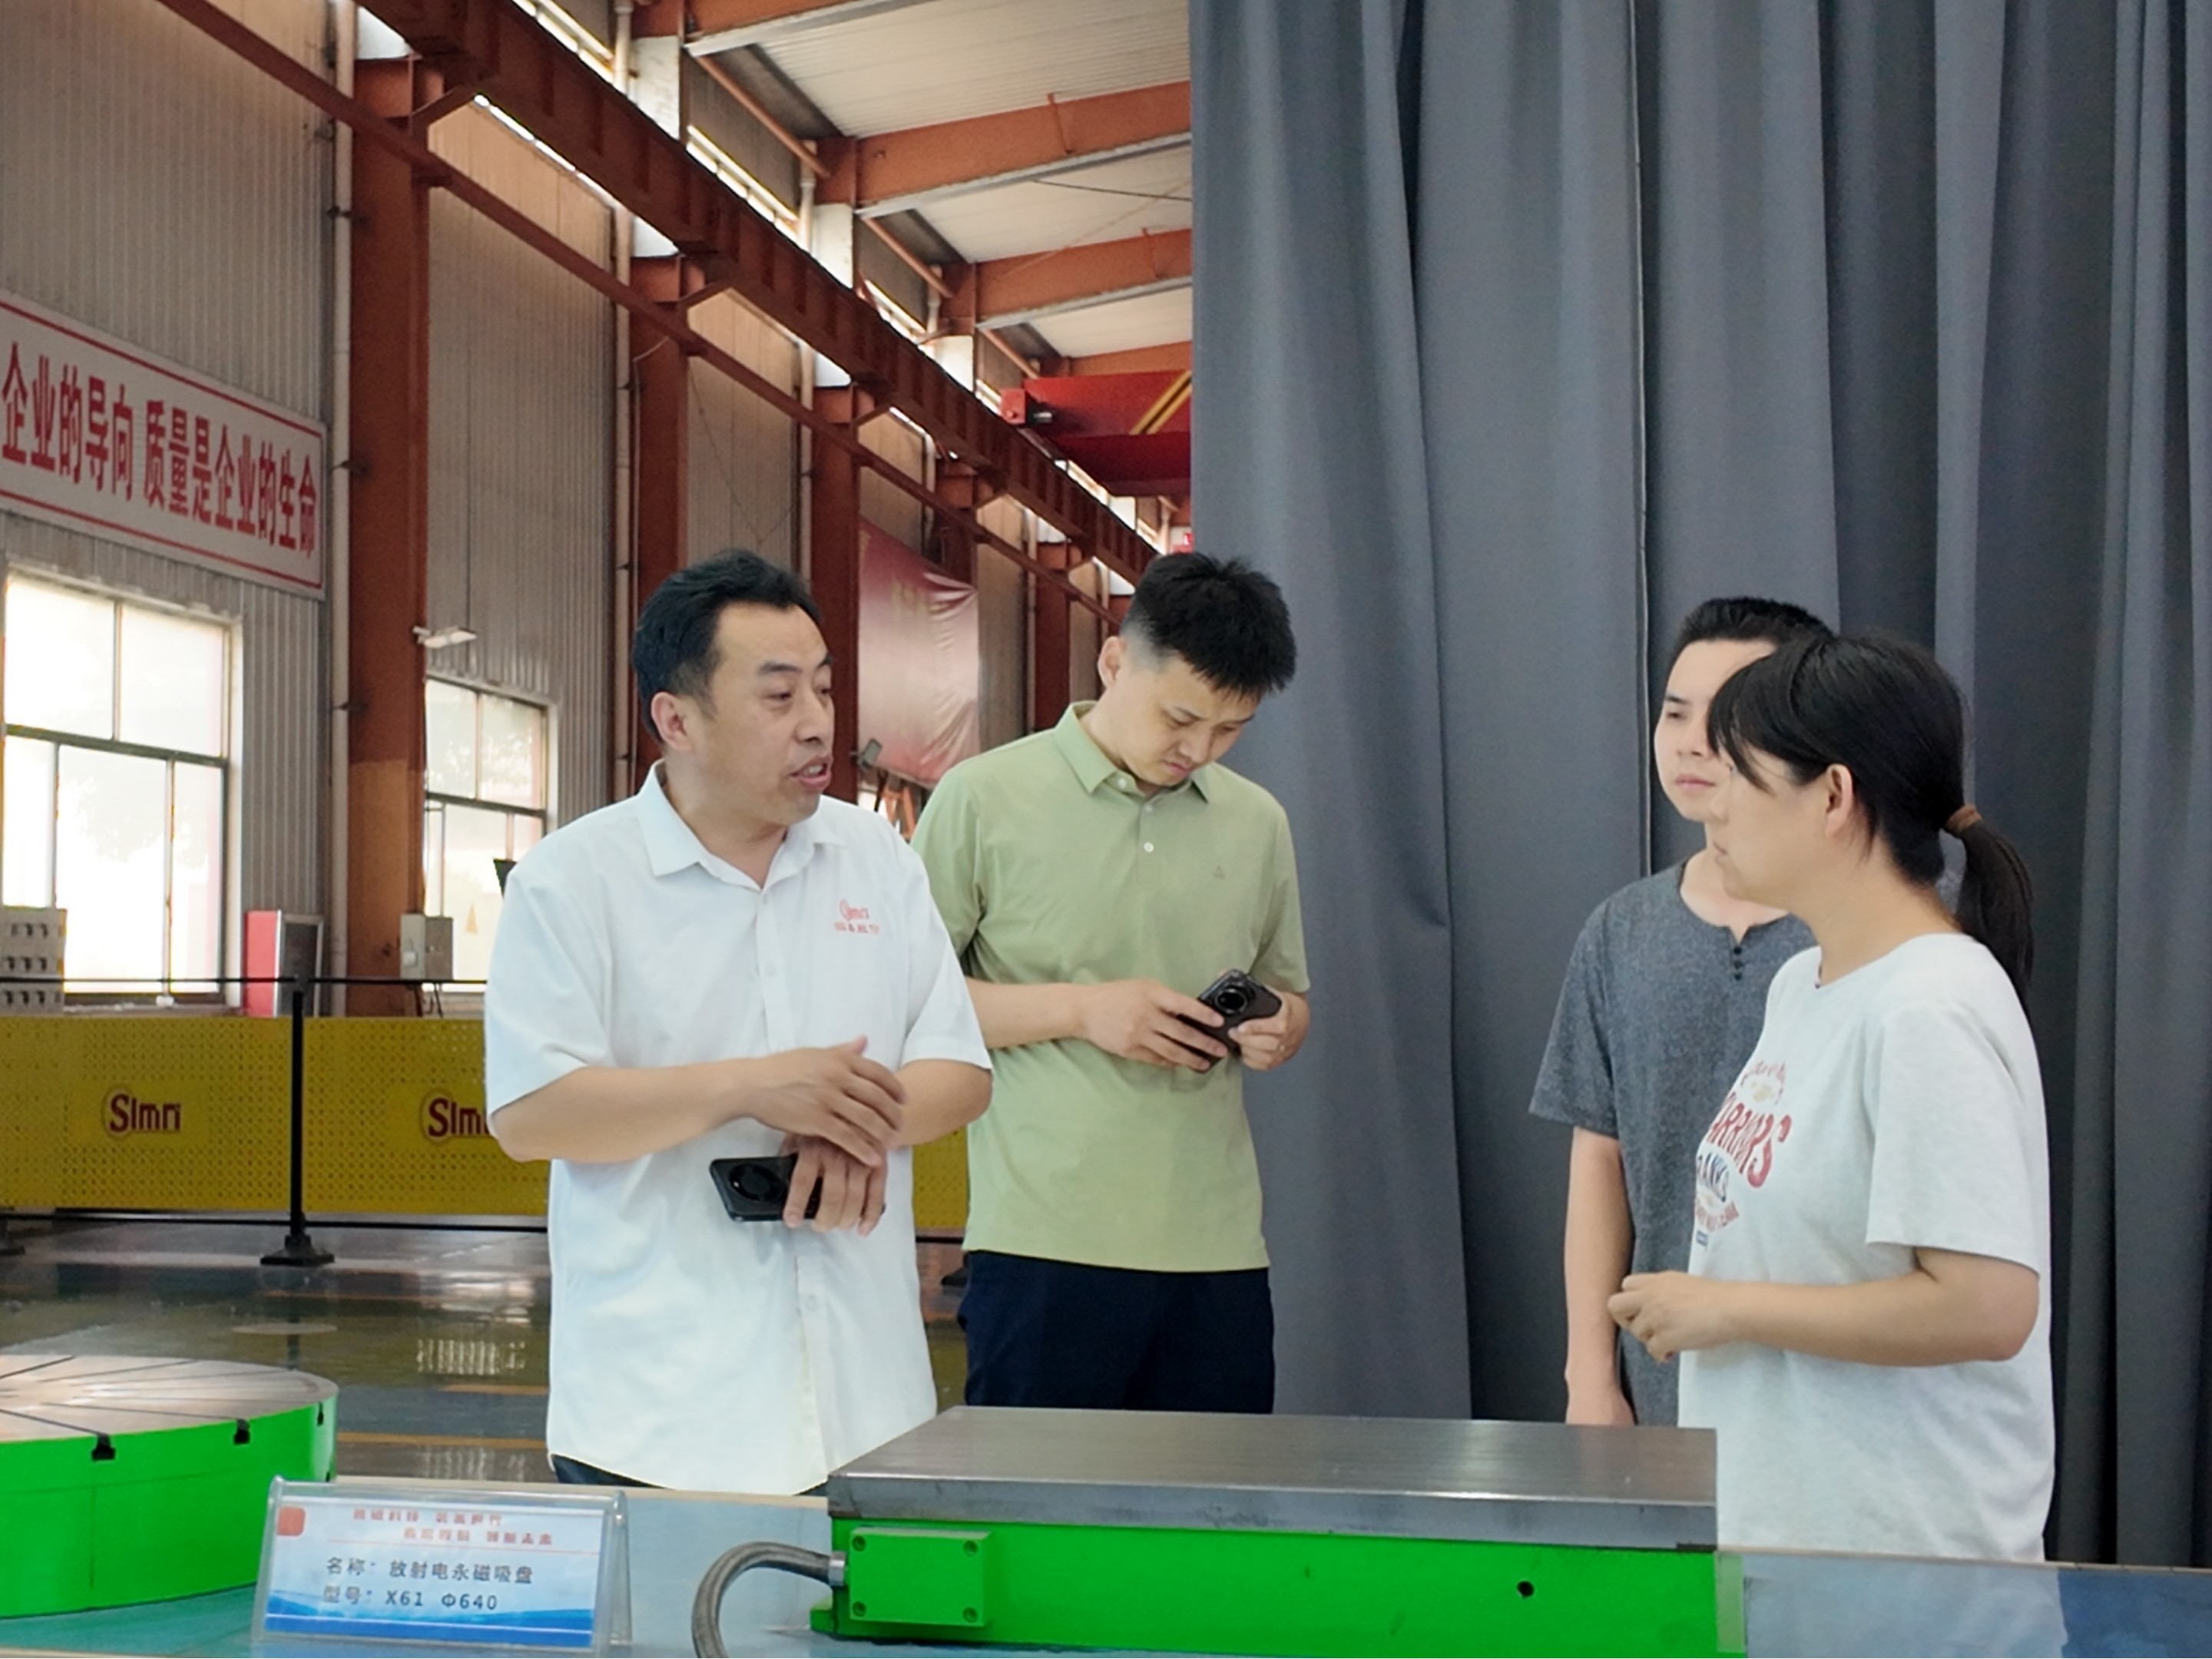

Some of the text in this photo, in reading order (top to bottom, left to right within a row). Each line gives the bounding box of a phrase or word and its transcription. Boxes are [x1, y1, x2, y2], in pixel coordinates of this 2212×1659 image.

[2, 341, 316, 558] 企业的导向 质量是企业的生命
